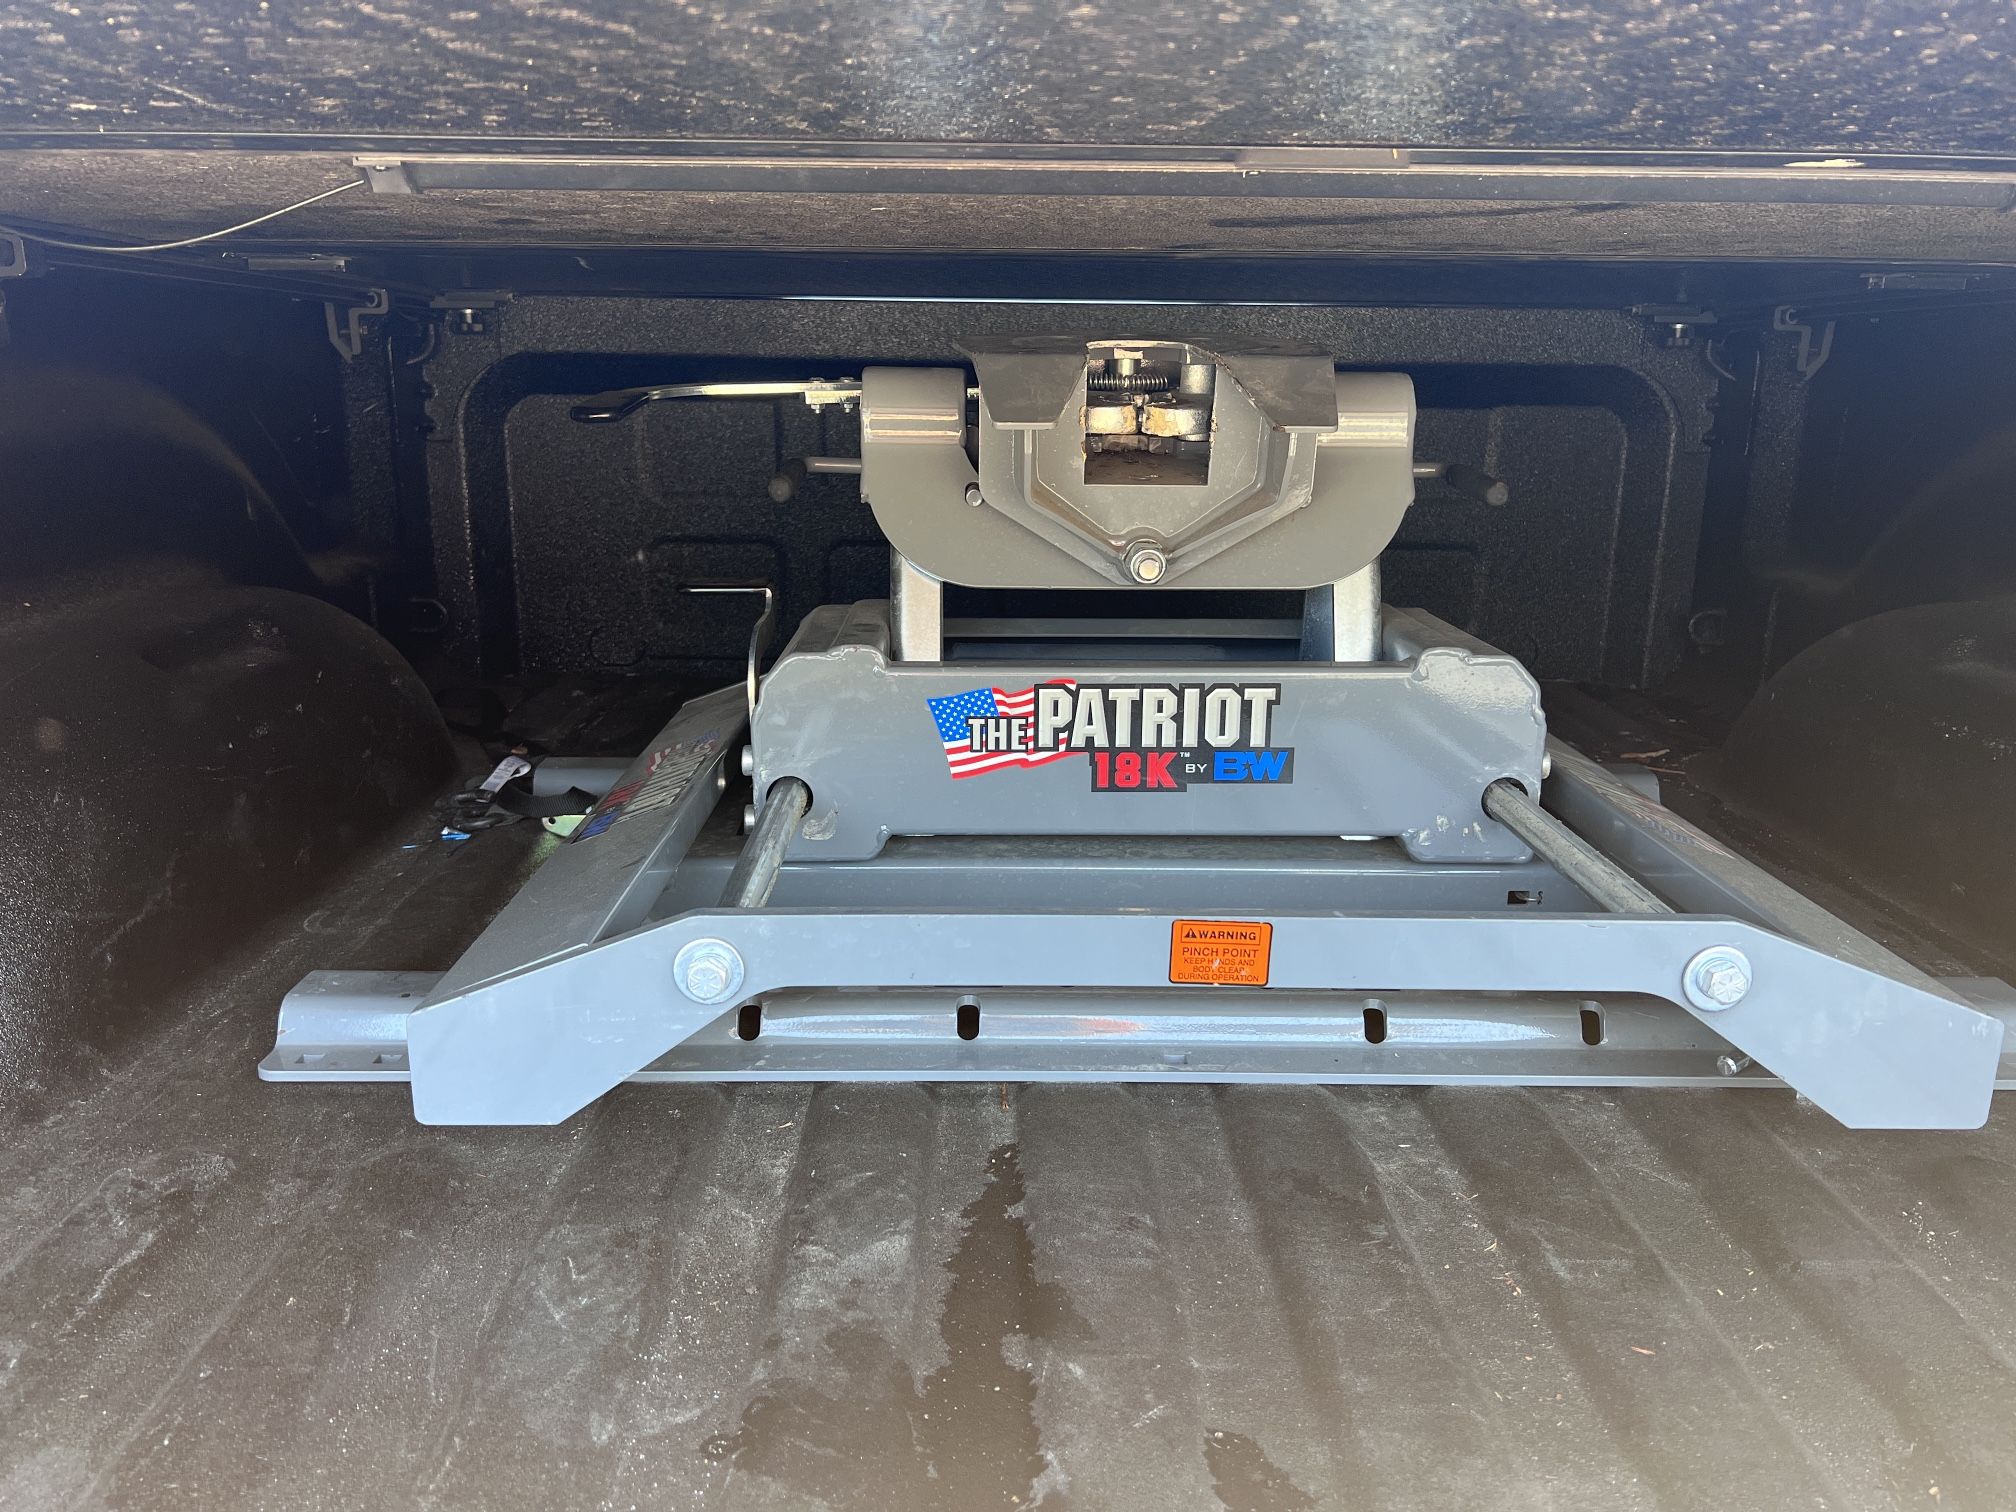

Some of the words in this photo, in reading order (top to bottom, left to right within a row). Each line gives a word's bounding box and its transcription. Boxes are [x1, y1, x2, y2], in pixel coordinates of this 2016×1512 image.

[968, 718, 1027, 750] THE
[1038, 688, 1276, 748] PATRIOT
[1095, 752, 1178, 788] 18K
[1185, 763, 1207, 773] BY
[1198, 930, 1257, 940] WARNING
[1182, 946, 1219, 956] PINCH
[1223, 948, 1259, 958] POINT
[1208, 958, 1236, 966] HNDS
[1238, 959, 1255, 967] AND
[1178, 972, 1209, 980] DURING
[1212, 973, 1260, 982] OPERATION
